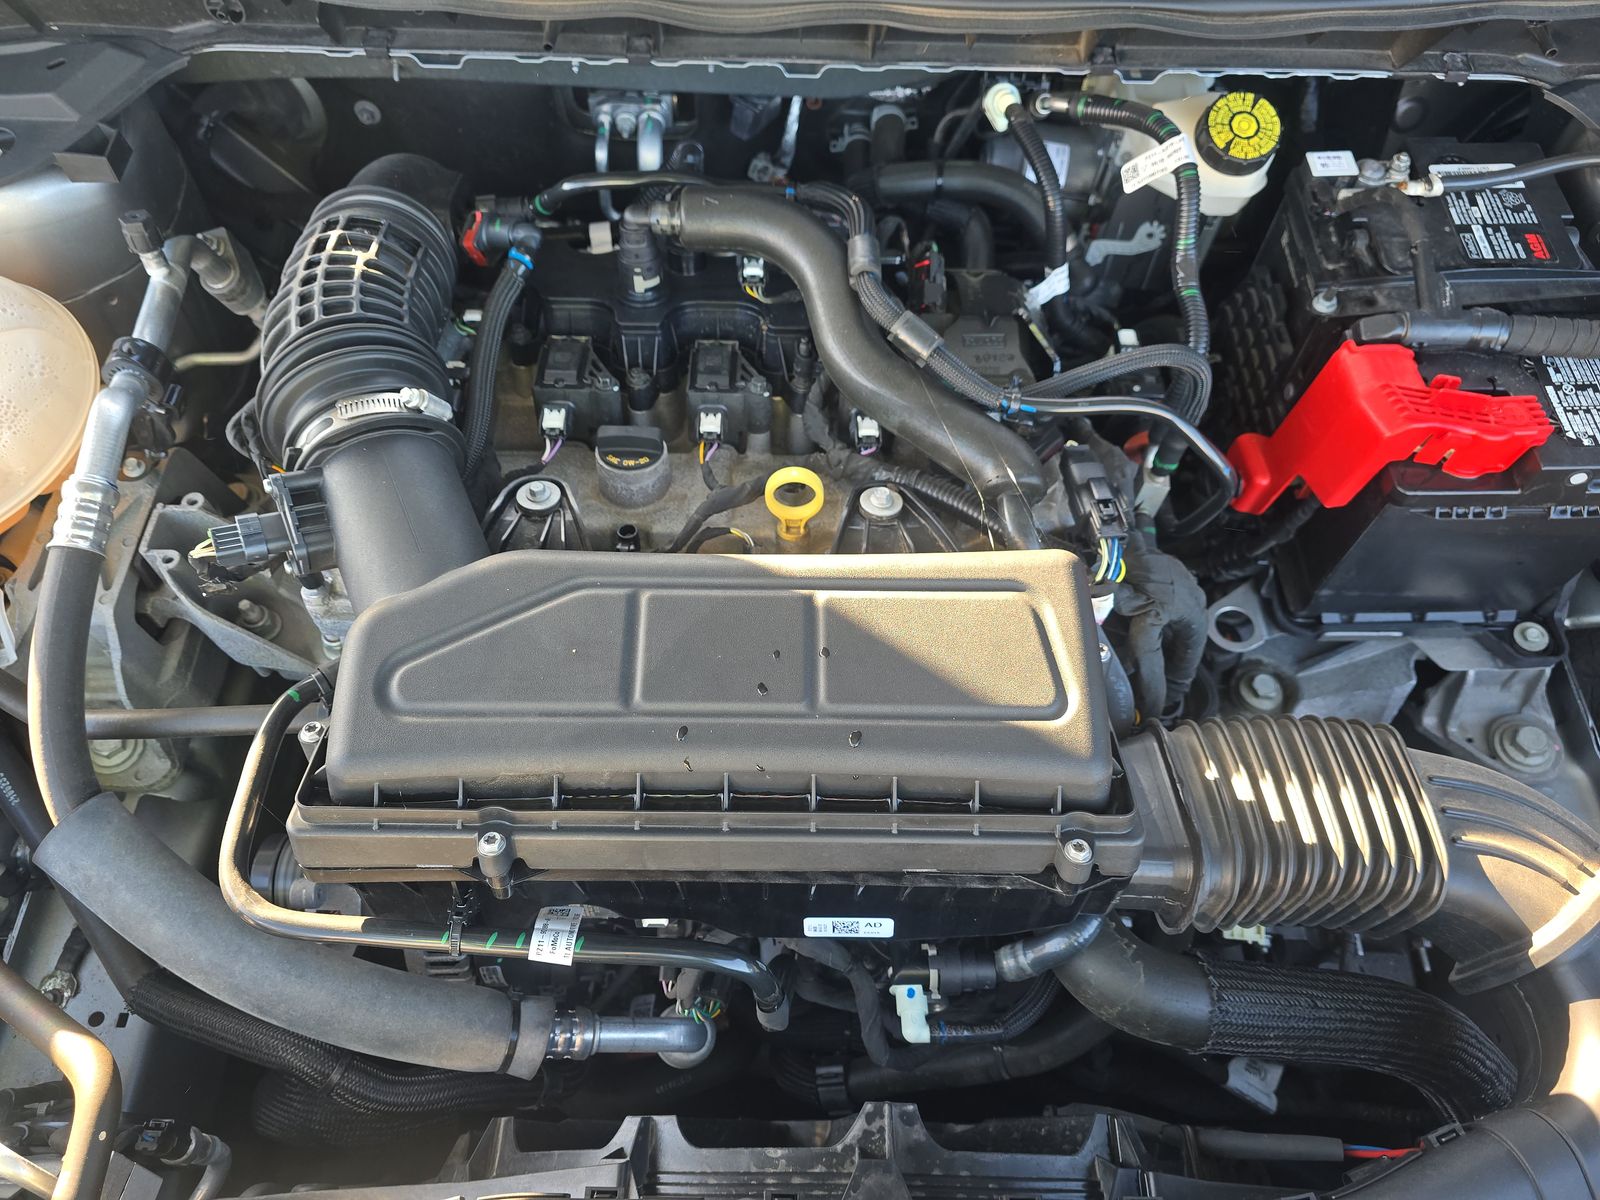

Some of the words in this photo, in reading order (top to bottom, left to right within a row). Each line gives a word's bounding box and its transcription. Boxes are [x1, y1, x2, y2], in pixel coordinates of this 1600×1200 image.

[1525, 233, 1546, 259] AGM
[605, 454, 620, 464] SAE
[622, 456, 649, 466] 0W-20
